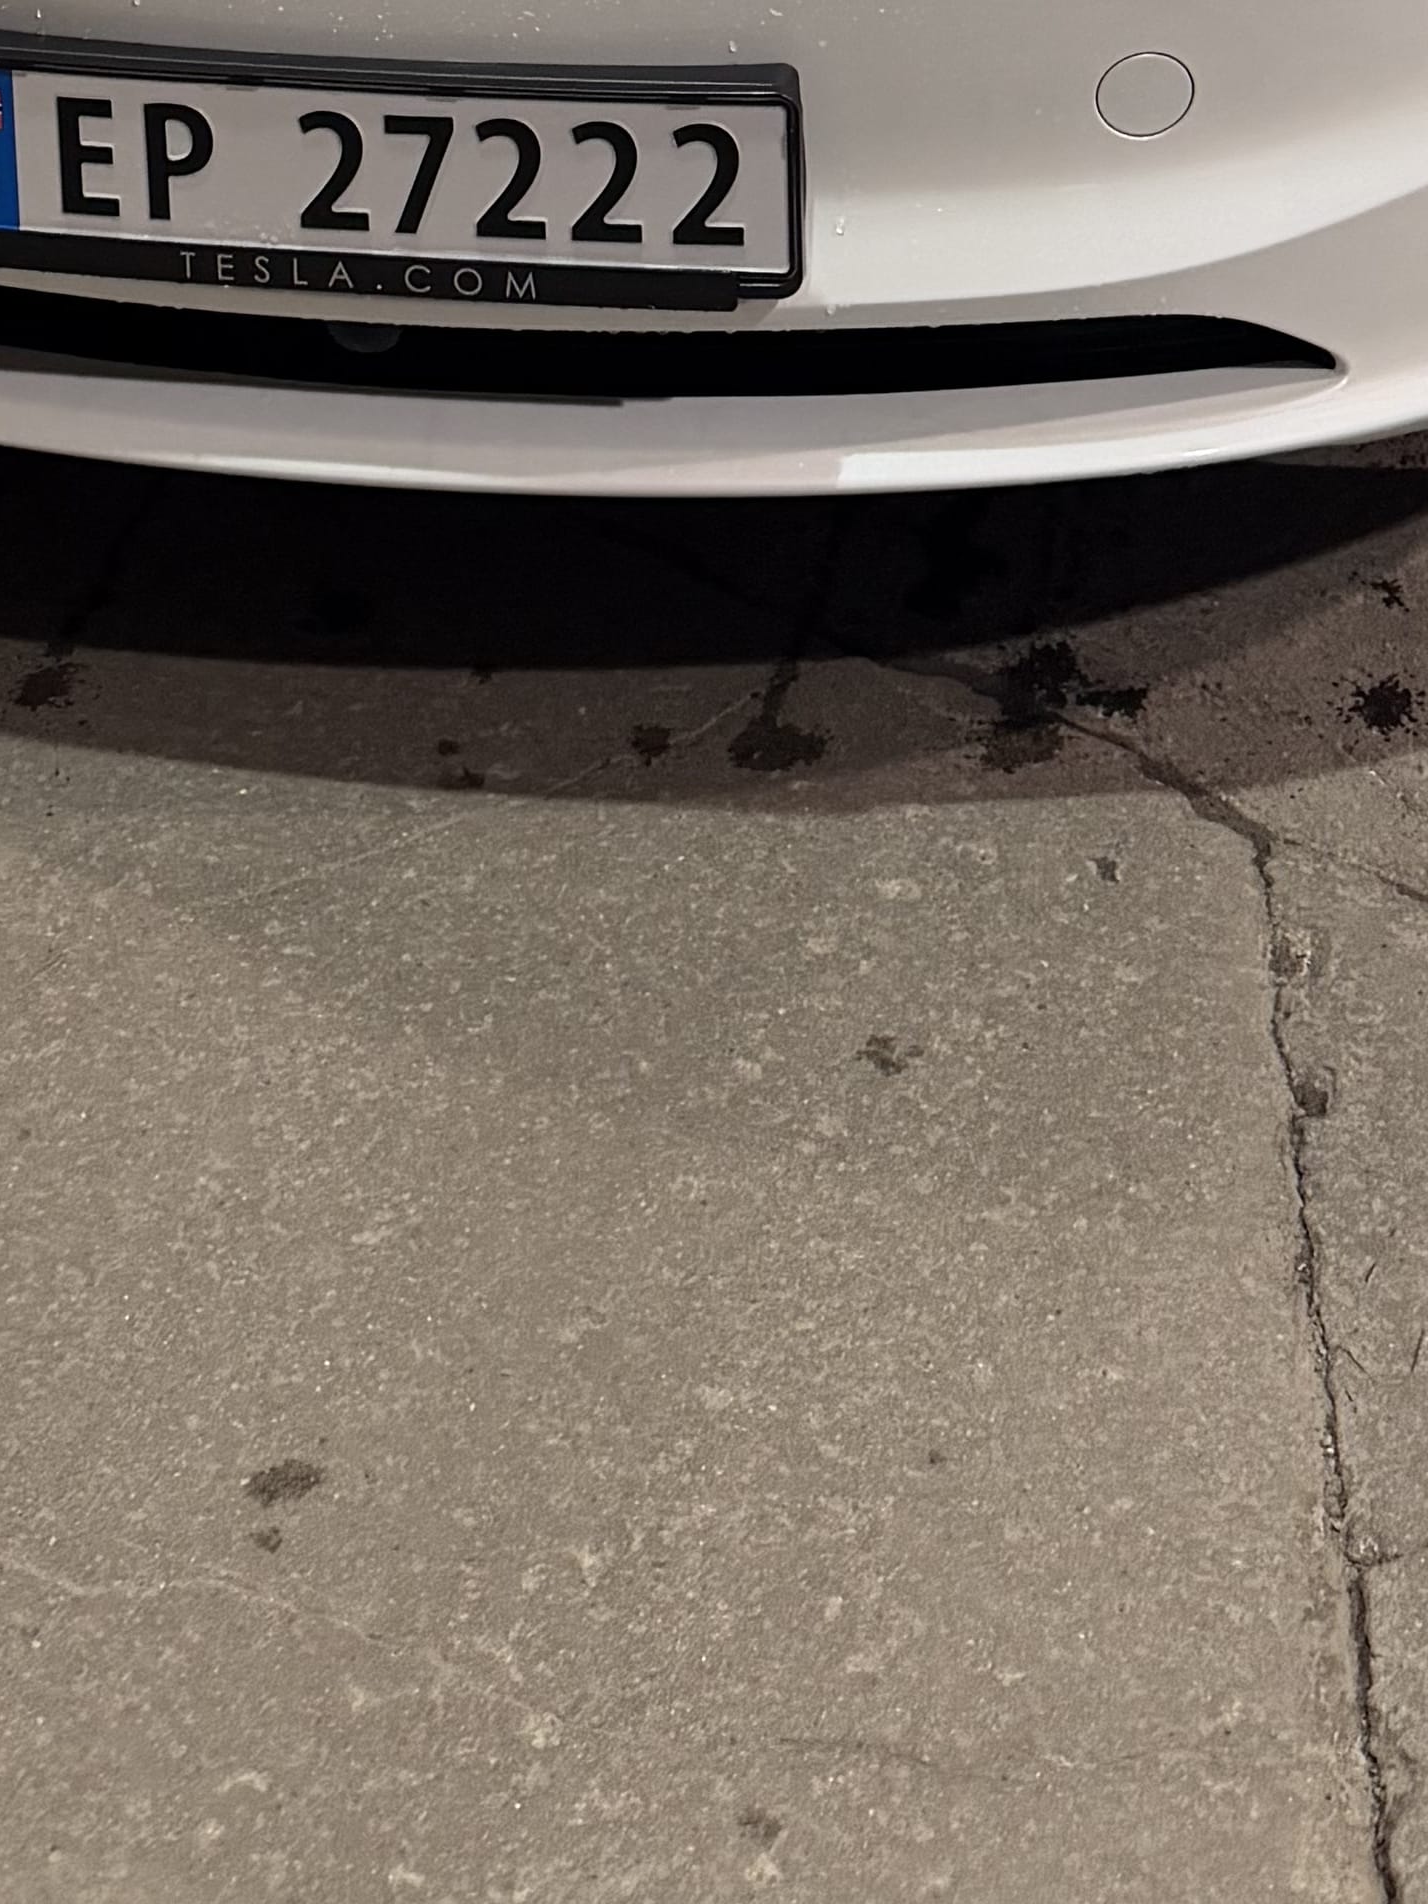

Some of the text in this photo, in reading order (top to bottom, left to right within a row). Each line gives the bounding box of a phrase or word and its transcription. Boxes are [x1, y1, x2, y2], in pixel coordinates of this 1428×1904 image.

[57, 96, 746, 247] EP 27222
[180, 250, 538, 301] TESLA.COM
